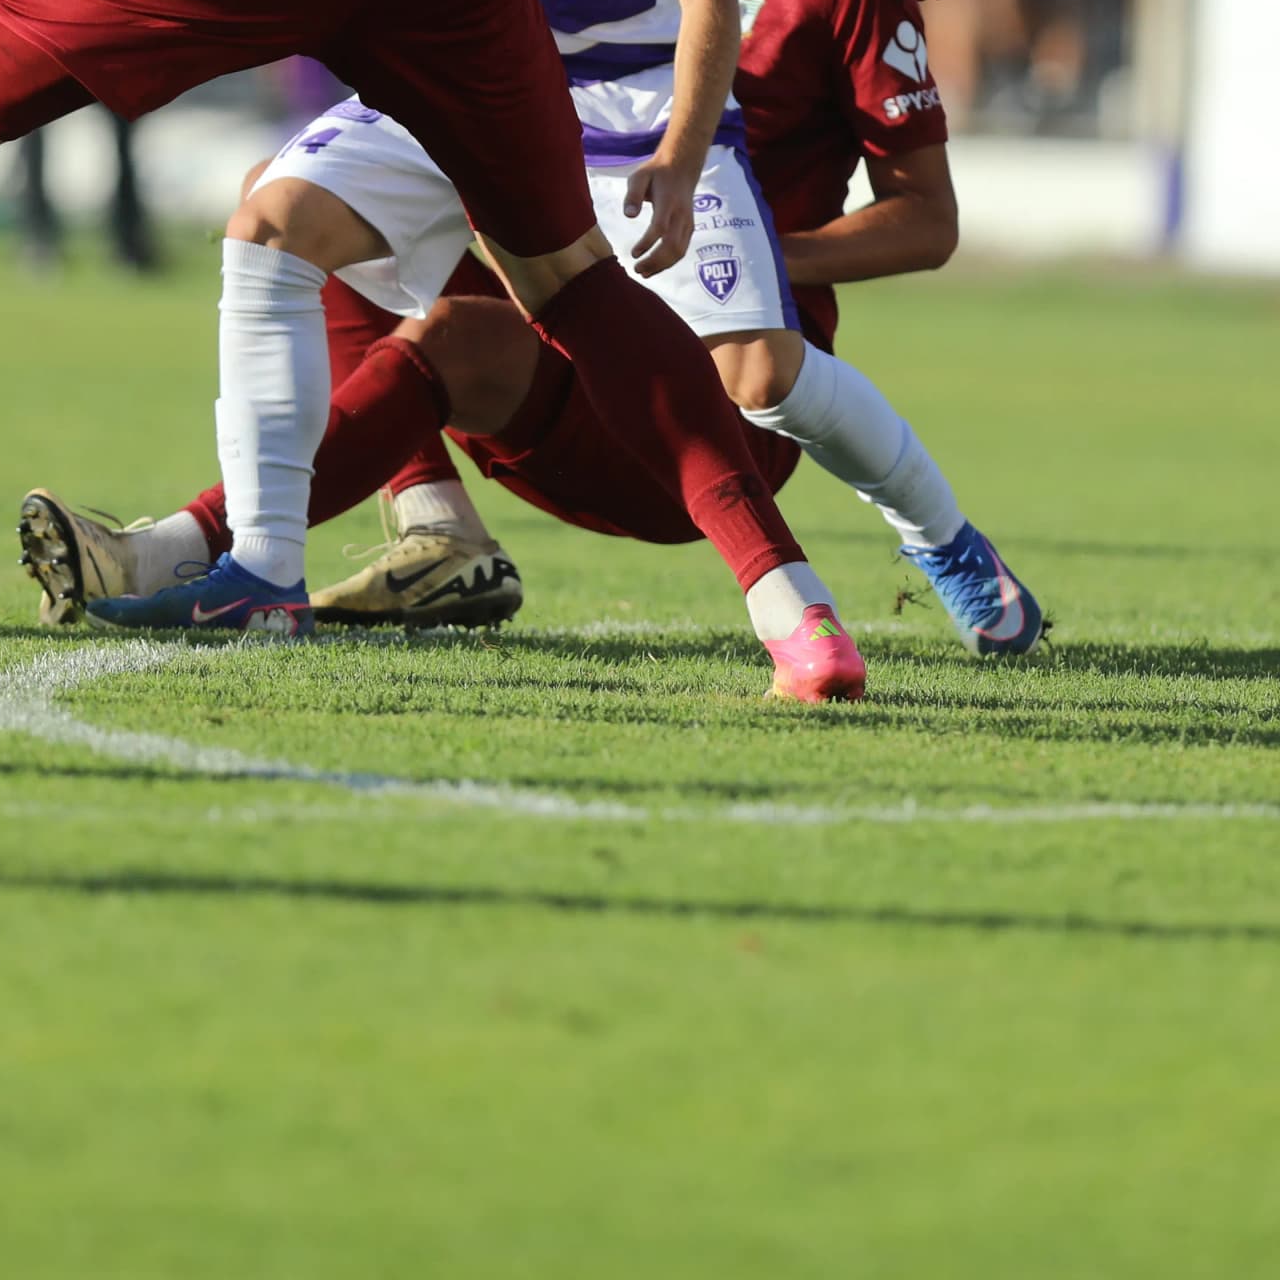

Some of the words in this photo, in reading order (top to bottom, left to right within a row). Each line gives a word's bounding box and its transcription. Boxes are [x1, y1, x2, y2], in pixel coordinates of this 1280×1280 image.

[711, 215, 756, 231] Eugen
[702, 262, 734, 281] POLI
[710, 279, 729, 296] T
